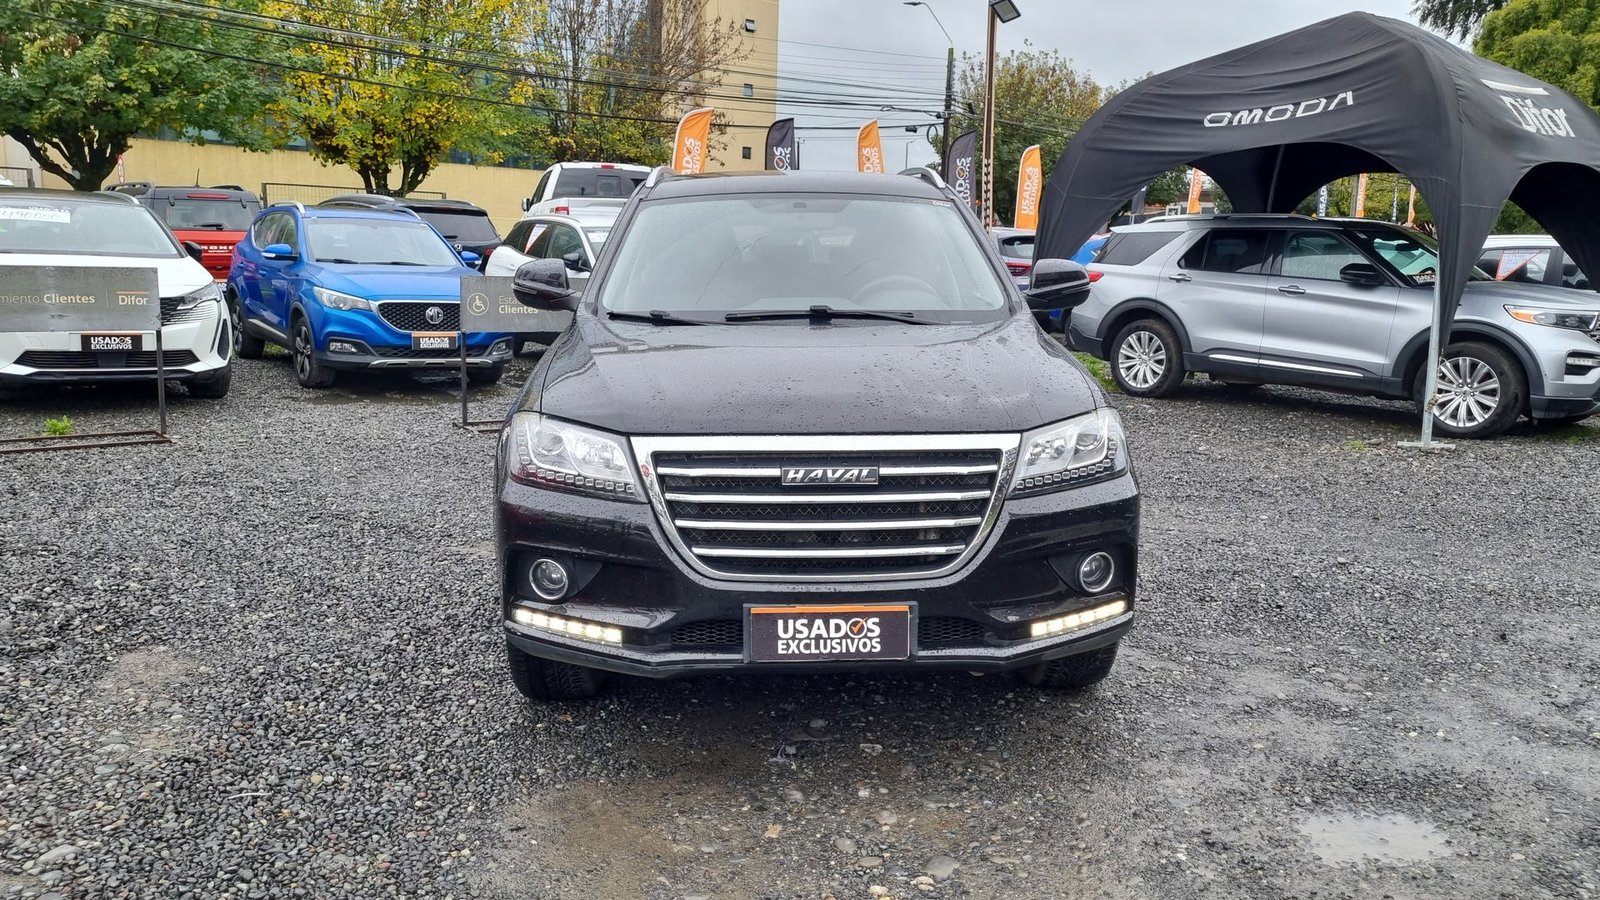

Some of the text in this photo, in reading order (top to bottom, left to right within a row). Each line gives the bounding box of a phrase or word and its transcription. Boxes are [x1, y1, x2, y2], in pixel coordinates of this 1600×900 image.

[1203, 91, 1354, 127] OMODA
[1500, 95, 1576, 138] Difor
[43, 294, 96, 304] Clientes
[118, 296, 149, 305] Difor
[426, 307, 443, 324] MG
[498, 304, 538, 314] Clientes
[90, 336, 132, 345] USADOS
[785, 469, 876, 483] HAVAL
[777, 617, 880, 639] USADOS
[777, 638, 881, 654] EXCLUSIVOS
